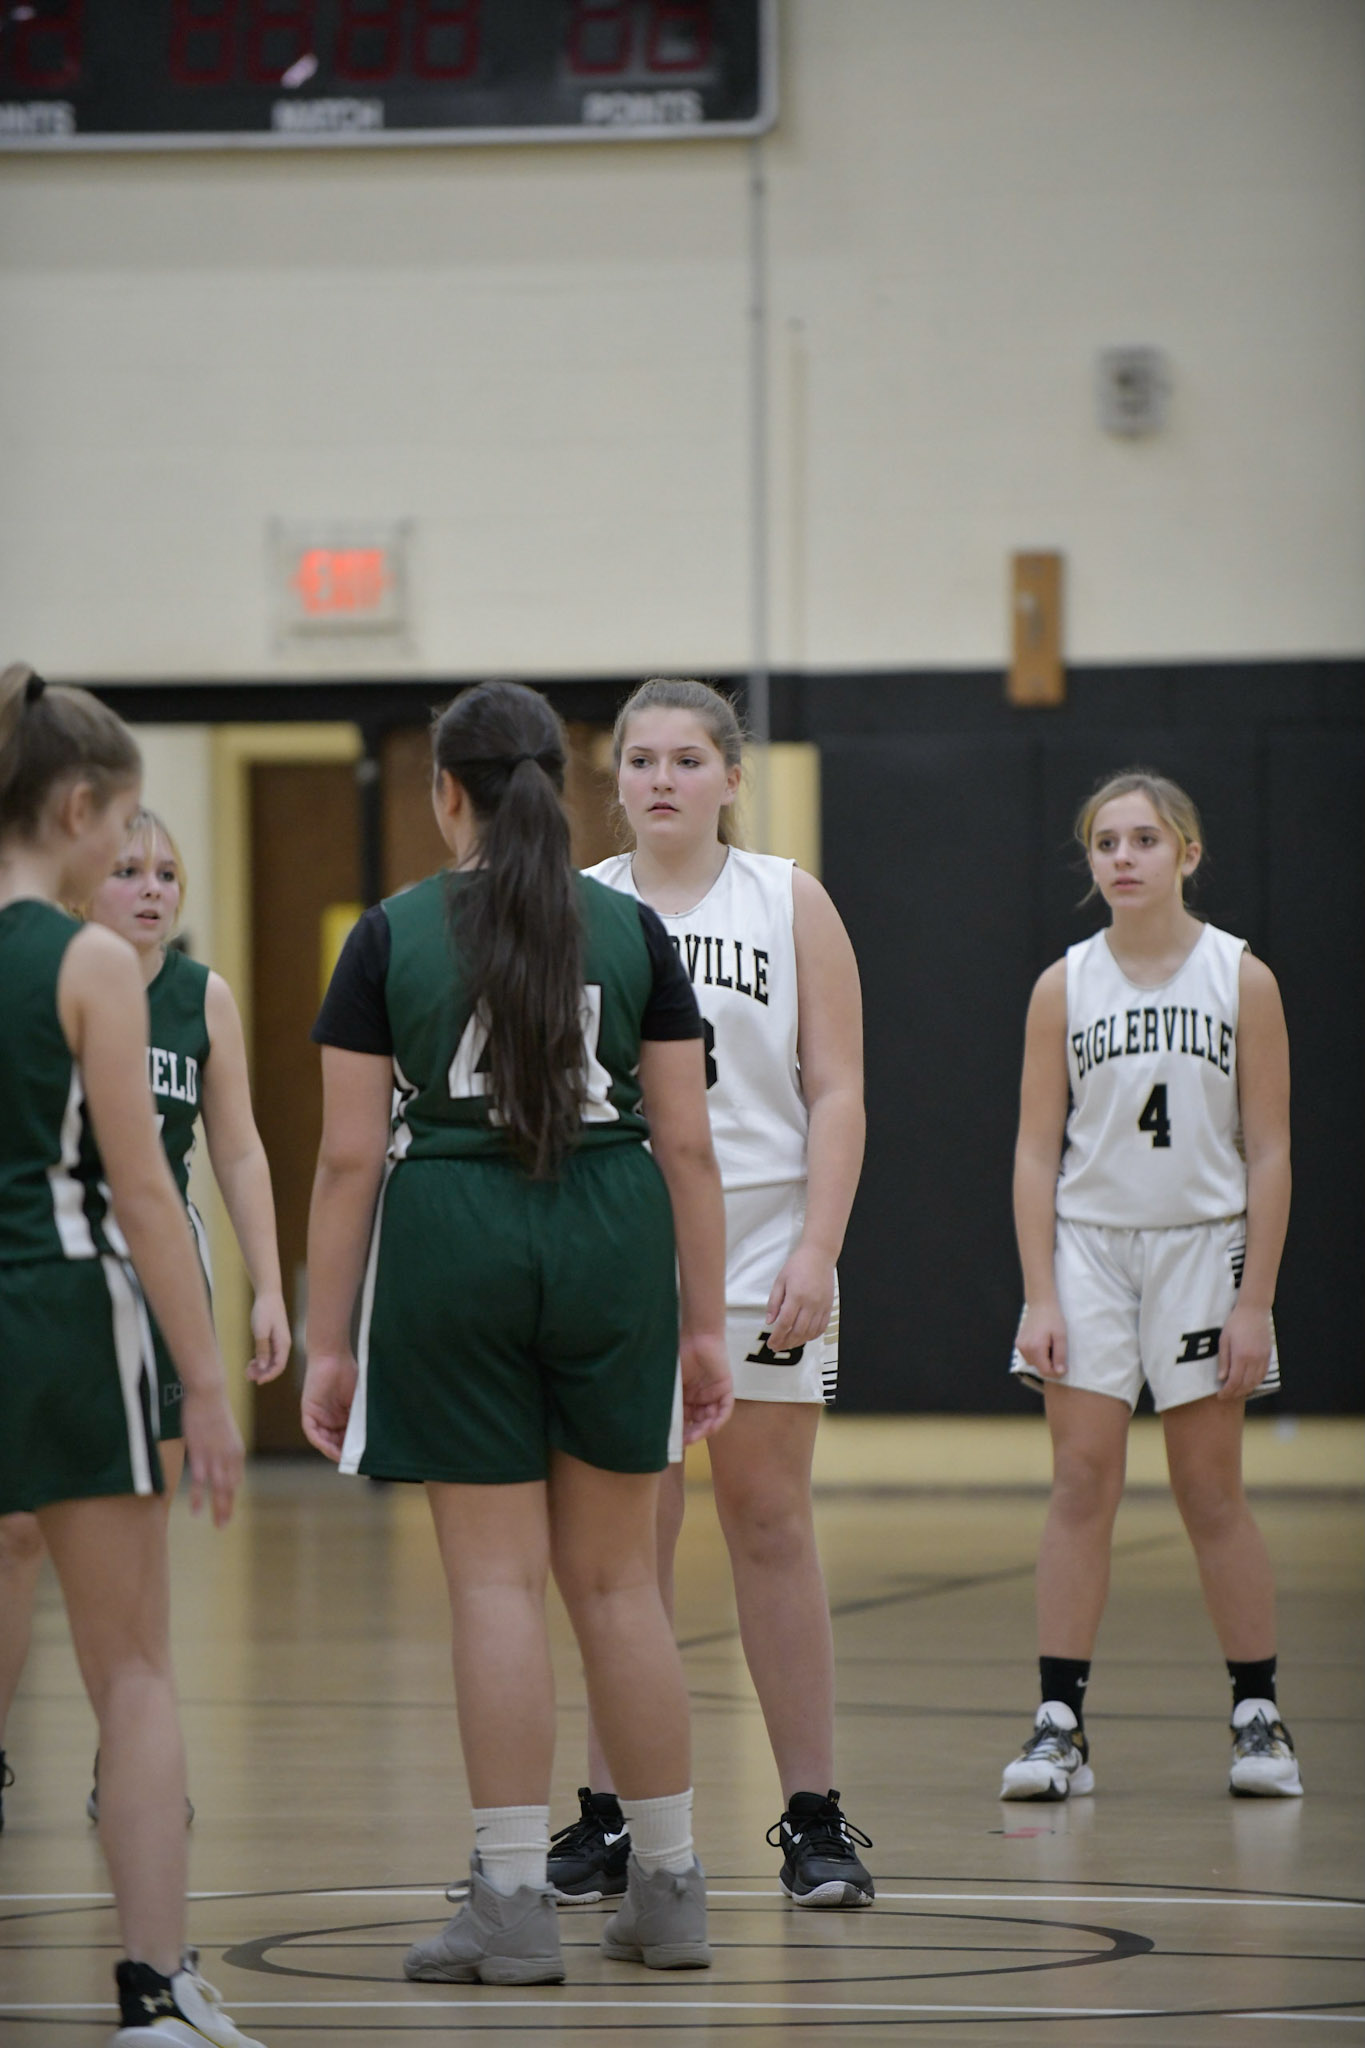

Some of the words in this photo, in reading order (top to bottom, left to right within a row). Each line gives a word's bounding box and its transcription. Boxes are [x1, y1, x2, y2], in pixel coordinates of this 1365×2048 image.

[583, 91, 702, 126] POINTS
[301, 549, 385, 614] EXIT
[1072, 1006, 1233, 1080] BIGLERVILLE
[1138, 1083, 1171, 1148] 4
[1176, 1328, 1222, 1364] B
